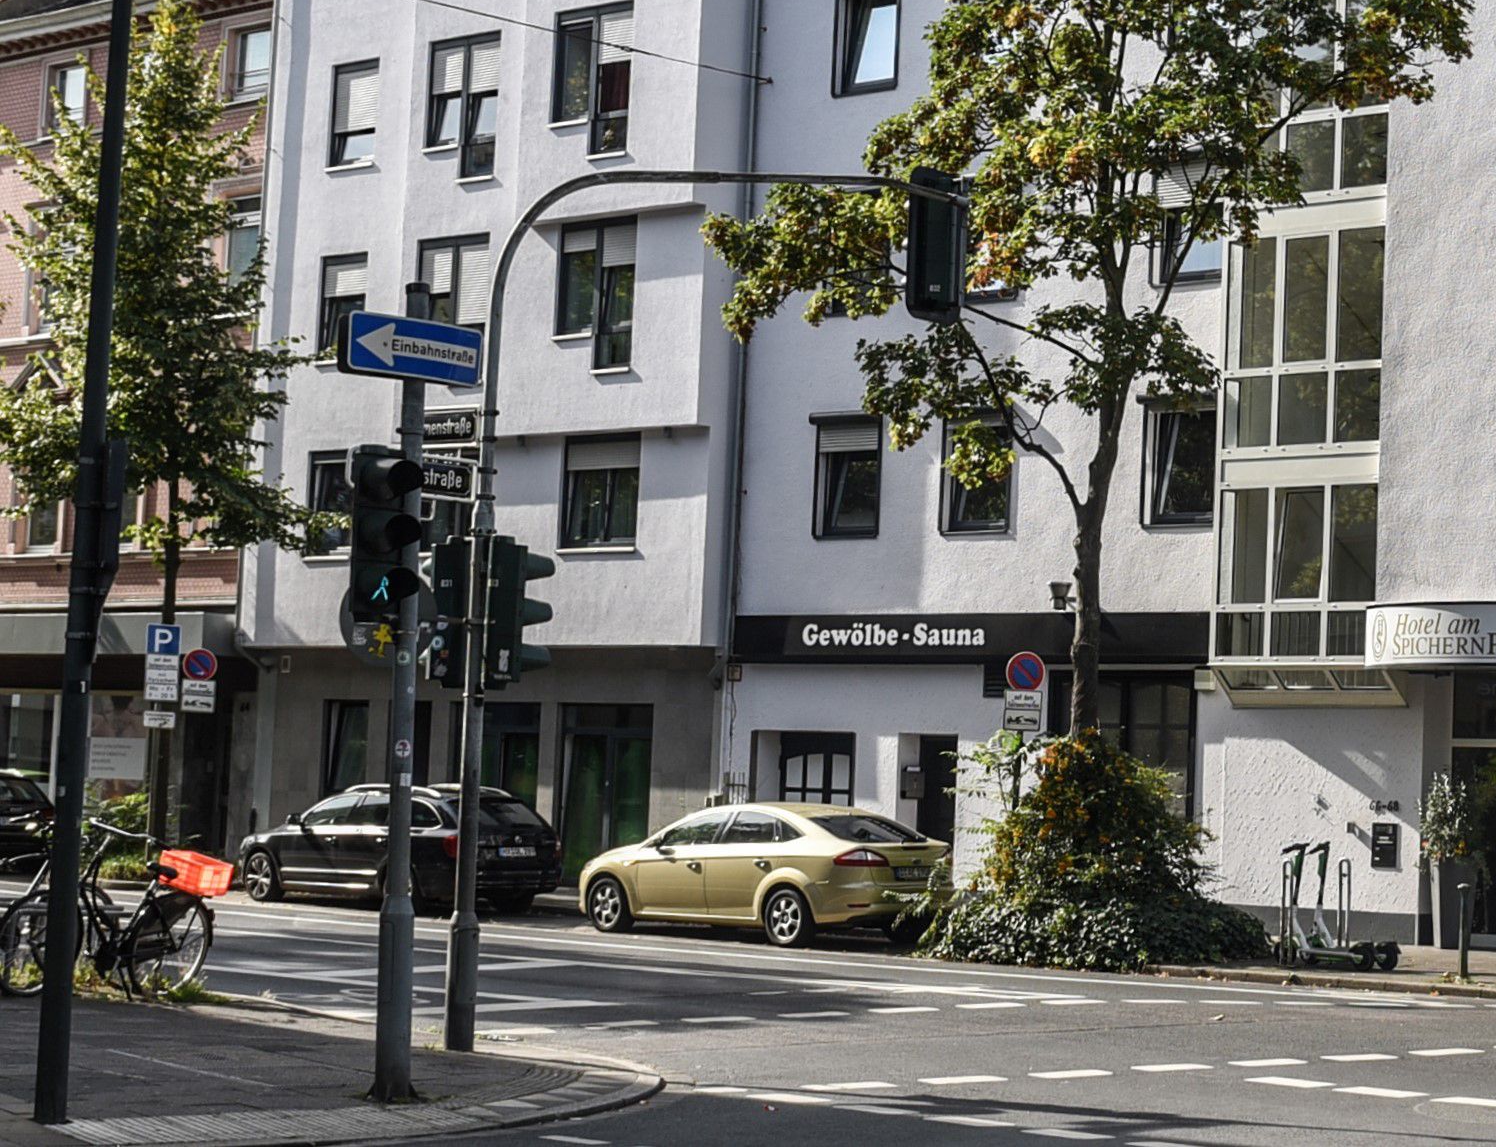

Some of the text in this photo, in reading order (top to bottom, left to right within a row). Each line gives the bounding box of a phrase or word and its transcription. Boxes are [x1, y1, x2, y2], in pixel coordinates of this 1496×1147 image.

[391, 338, 474, 365] Einbahnstraße
[423, 416, 472, 436] menstraße
[423, 468, 463, 489] straße
[1395, 612, 1480, 635] Hotel am
[154, 628, 173, 653] P
